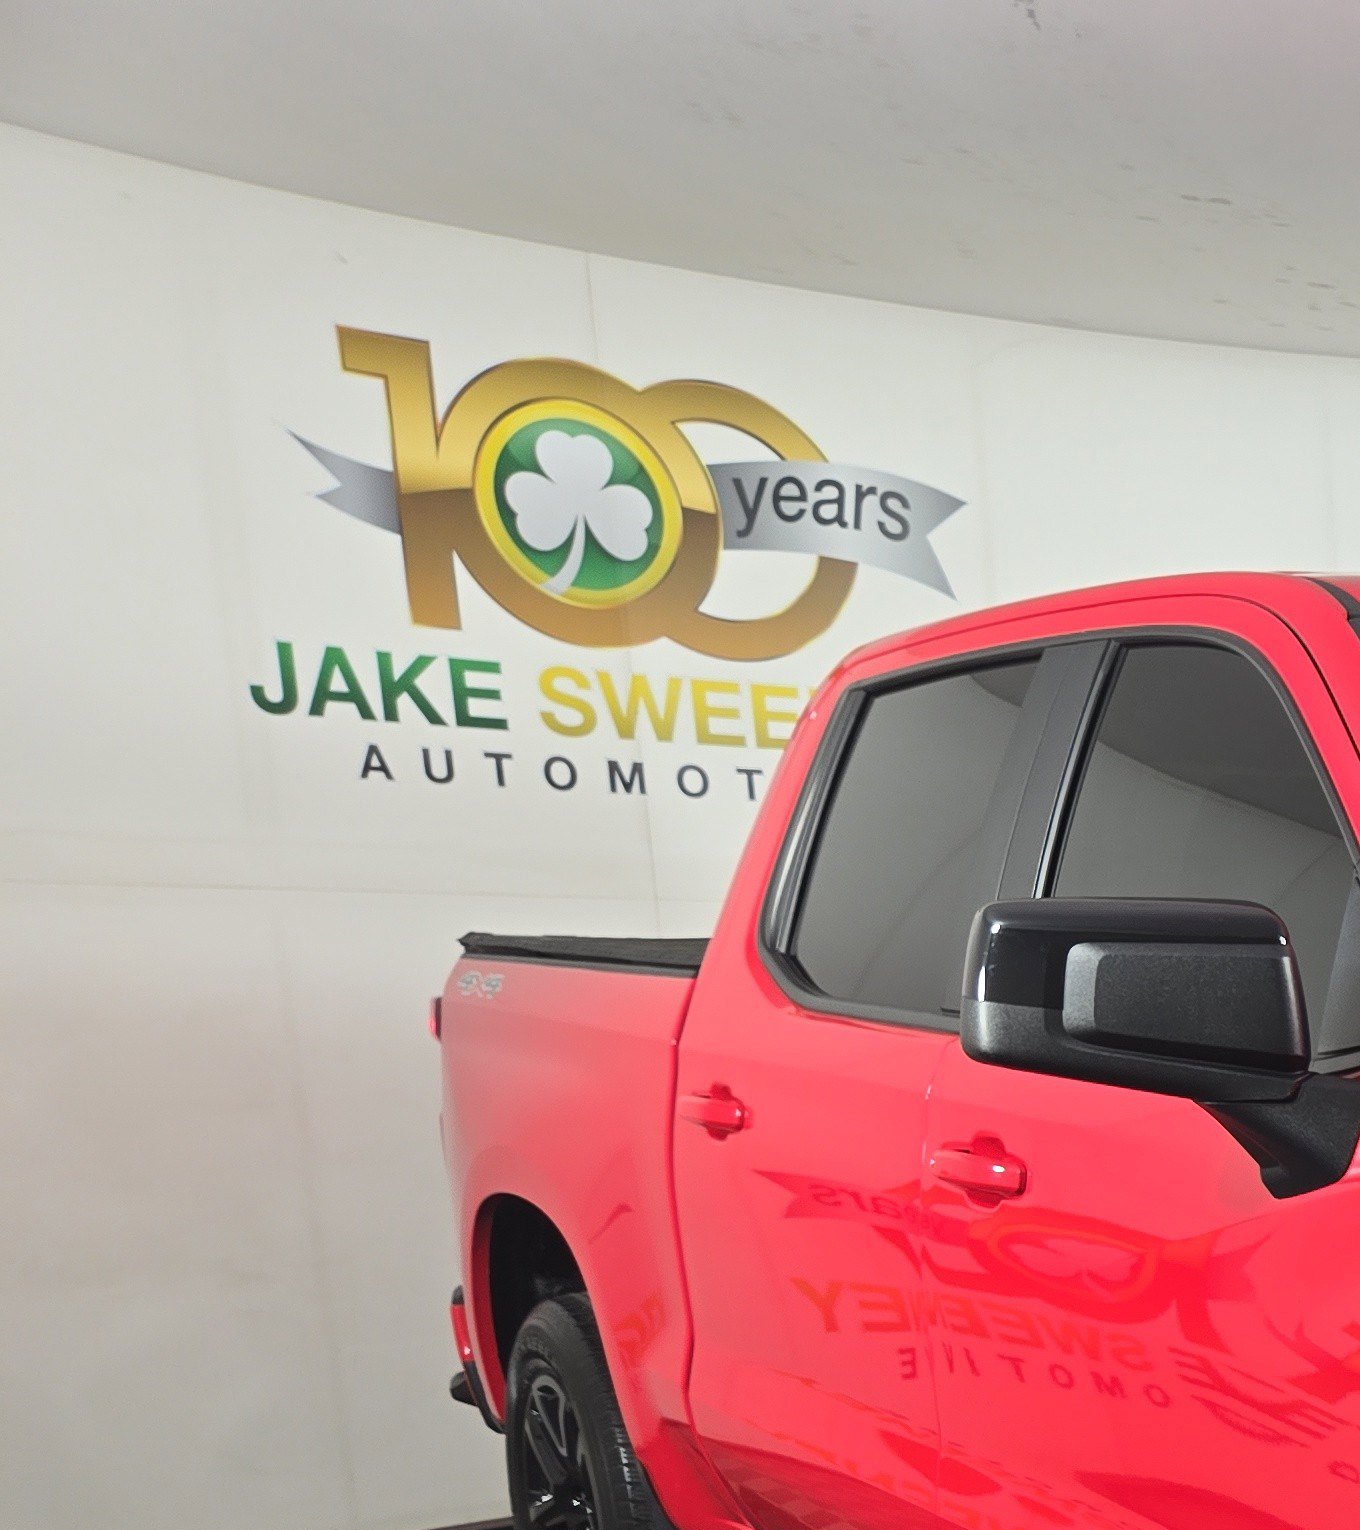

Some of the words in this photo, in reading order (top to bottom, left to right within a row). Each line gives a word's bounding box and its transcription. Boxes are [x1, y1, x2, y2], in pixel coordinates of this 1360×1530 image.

[335, 324, 858, 661] 100
[732, 475, 912, 542] years
[250, 641, 510, 731] JAKE
[537, 666, 817, 751] SWEE
